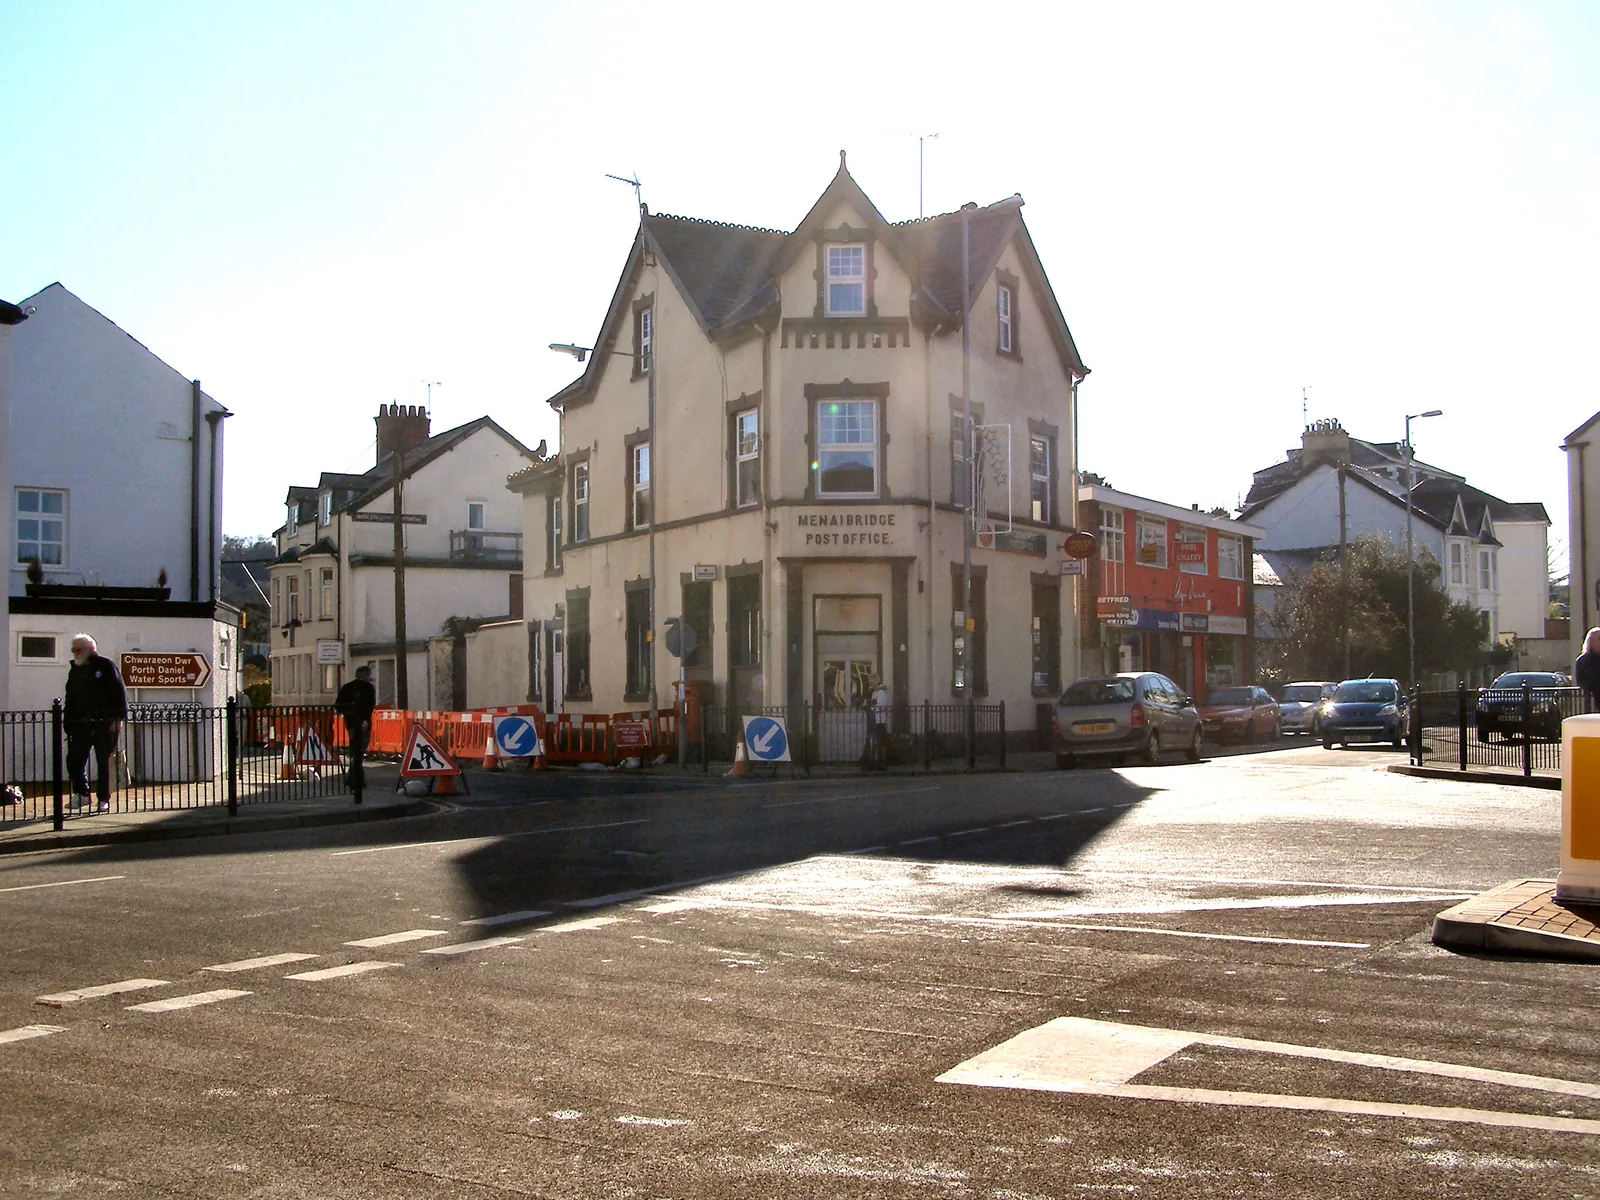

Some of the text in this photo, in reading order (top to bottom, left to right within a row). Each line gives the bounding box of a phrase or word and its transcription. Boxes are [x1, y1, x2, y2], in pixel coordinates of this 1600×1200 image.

[798, 514, 895, 526] MENAI BRIDGE
[806, 533, 839, 545] POST
[124, 655, 172, 664] Chwaraeon
[131, 666, 185, 674] Porth Daniel
[130, 675, 187, 684] Water Sports
